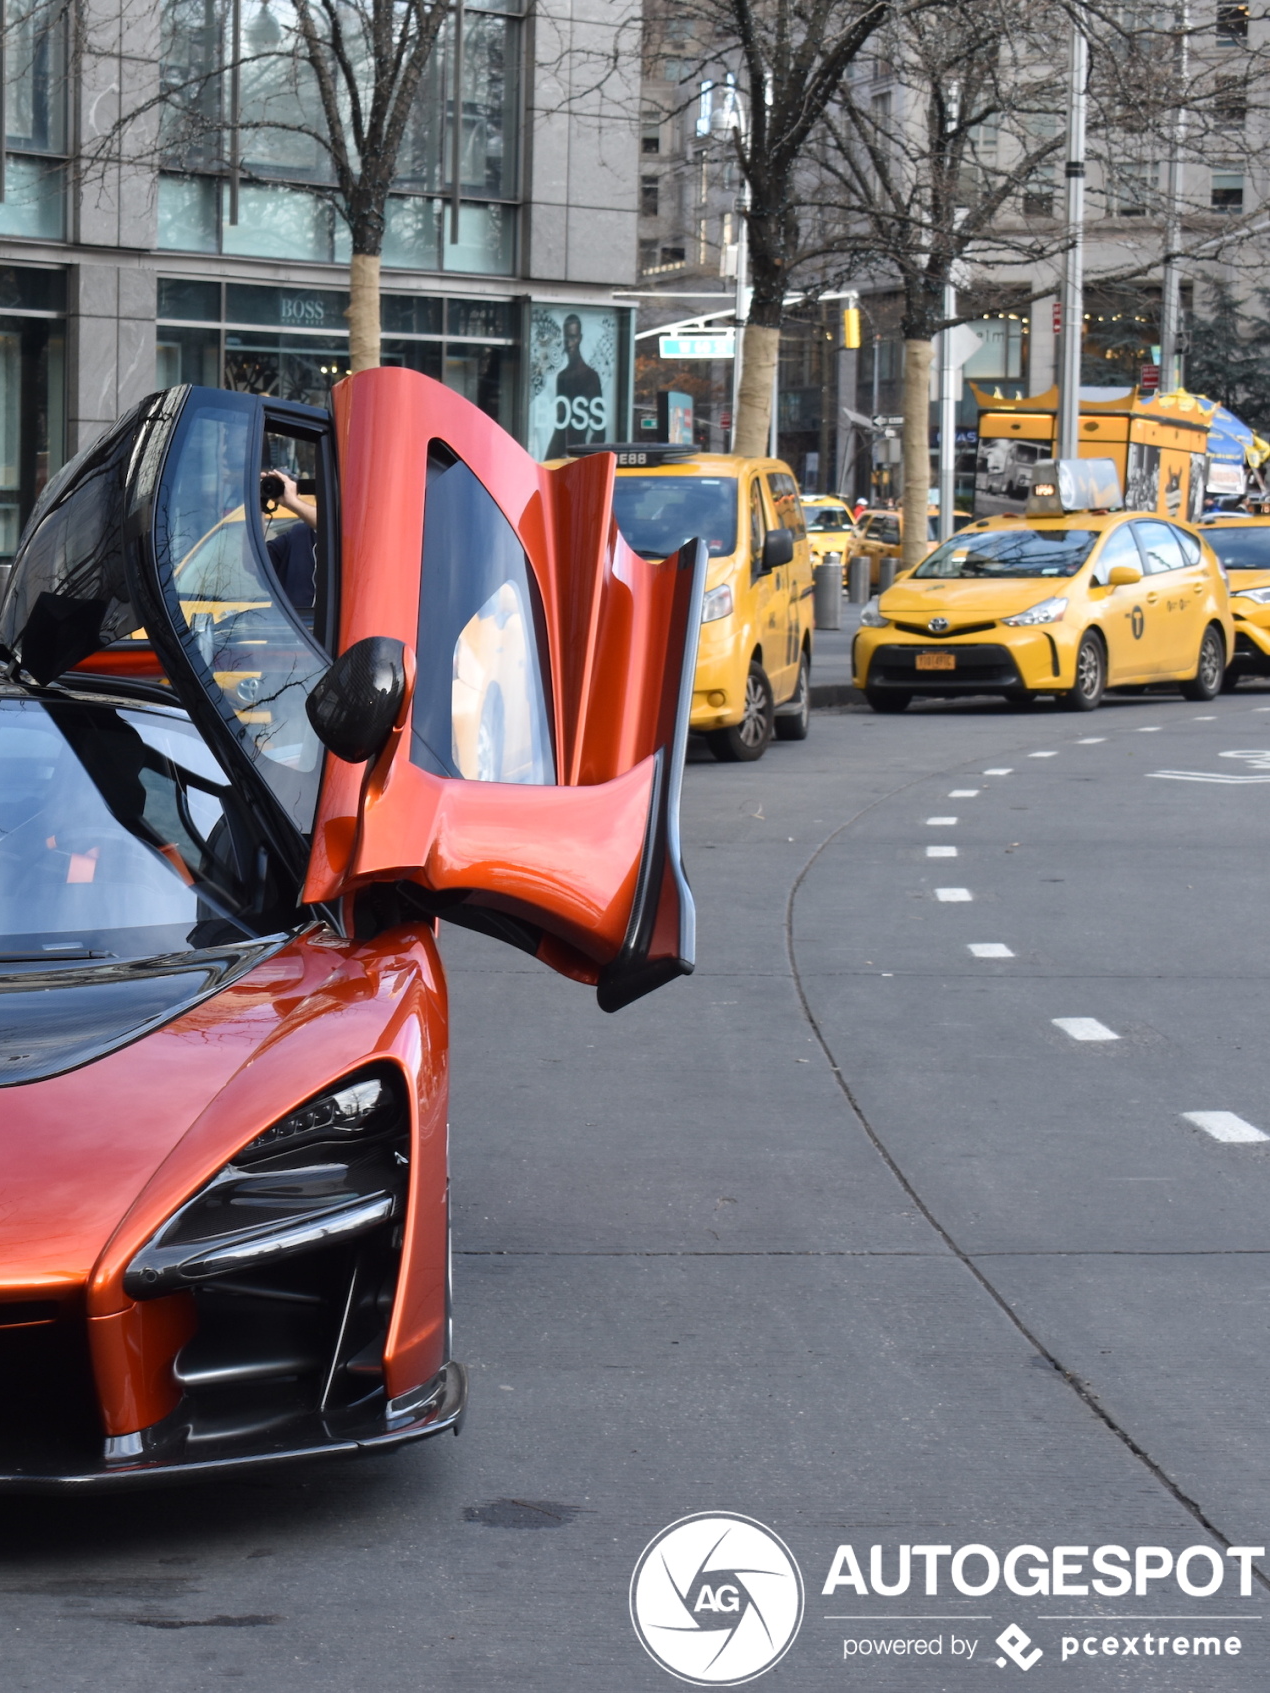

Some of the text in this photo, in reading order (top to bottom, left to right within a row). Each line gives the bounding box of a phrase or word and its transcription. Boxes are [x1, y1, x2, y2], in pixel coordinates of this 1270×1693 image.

[281, 298, 325, 320] BOSS
[534, 395, 607, 431] BOSS
[616, 453, 647, 465] E88
